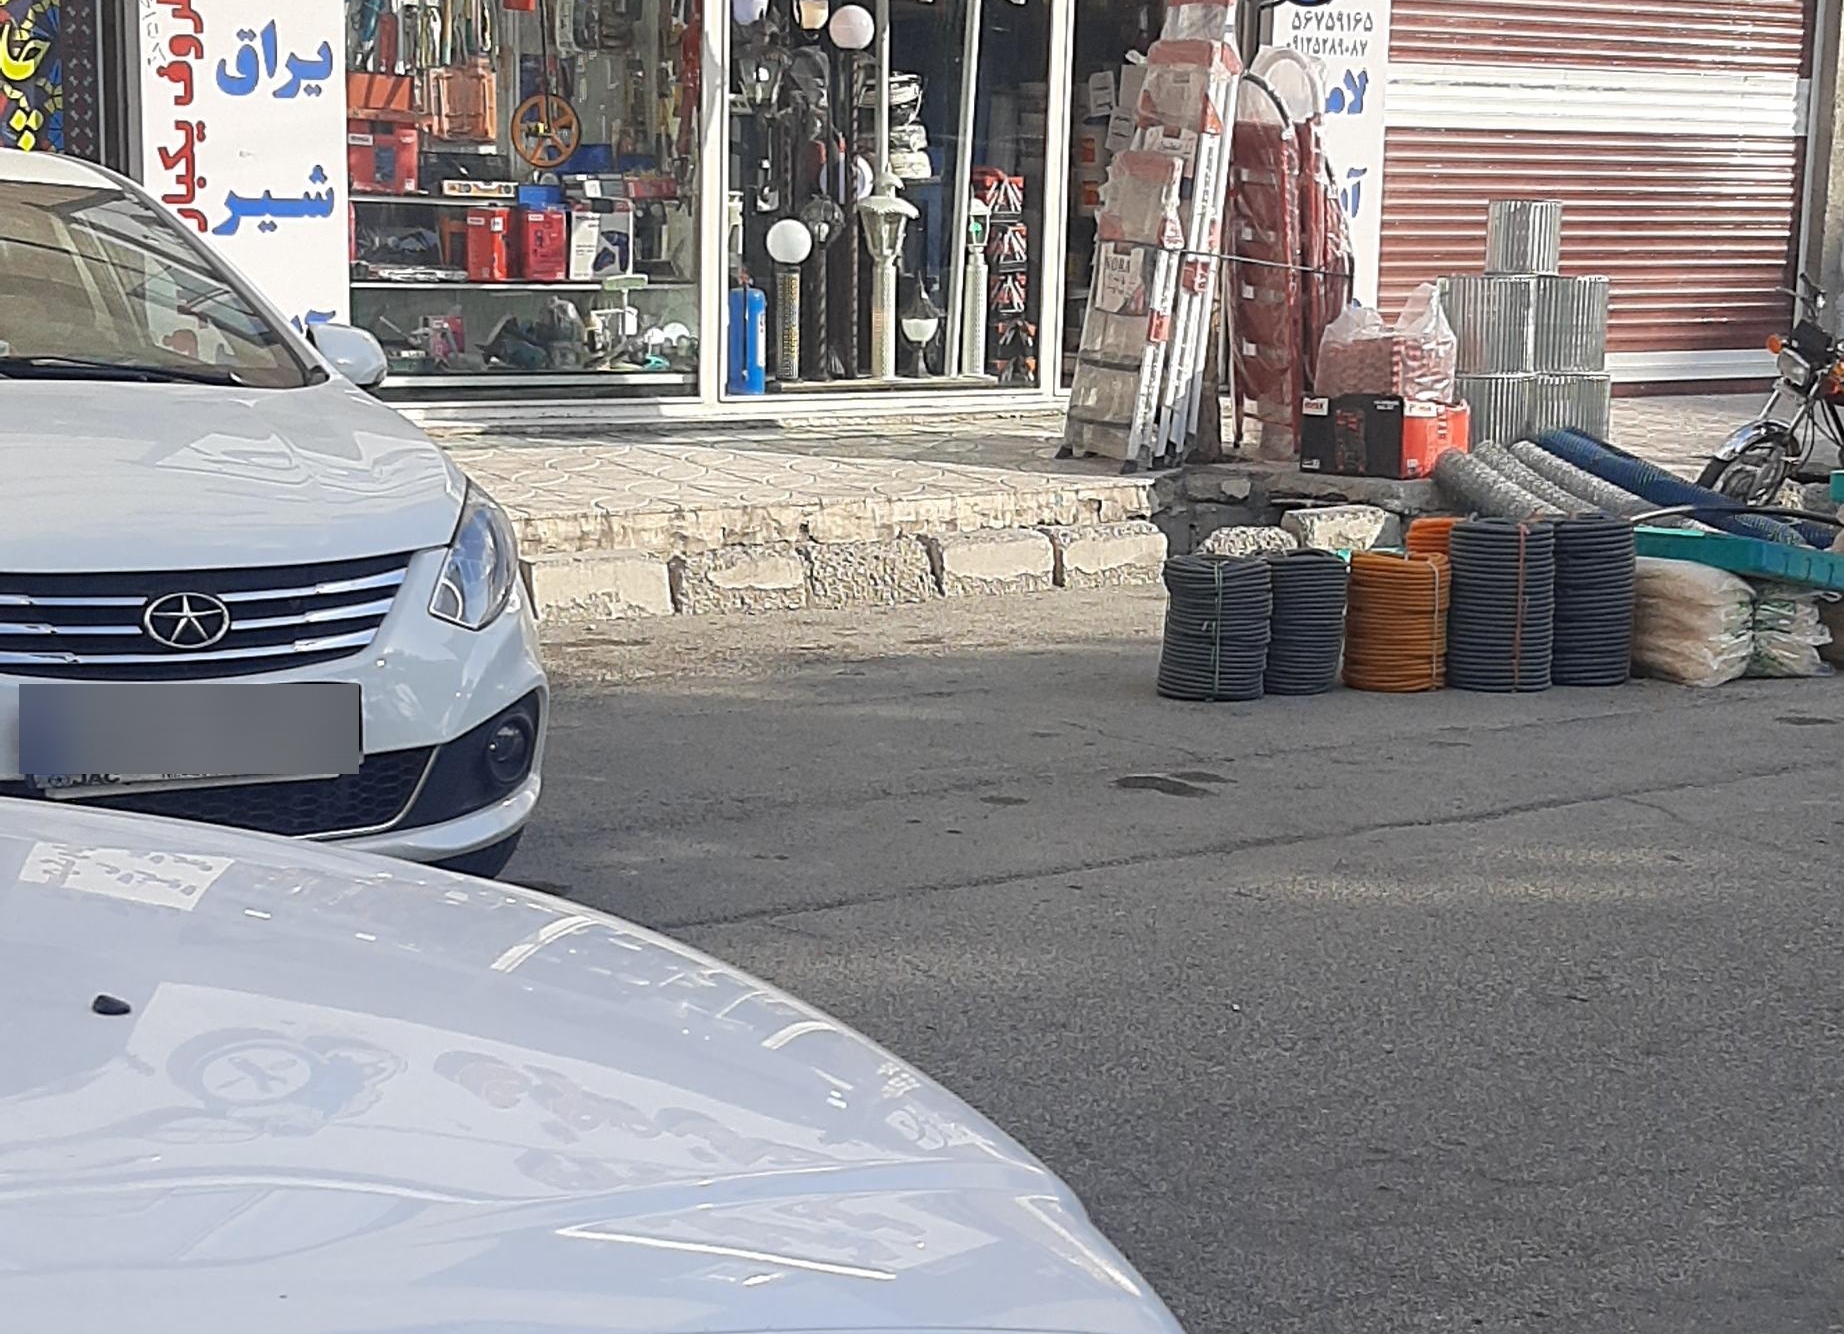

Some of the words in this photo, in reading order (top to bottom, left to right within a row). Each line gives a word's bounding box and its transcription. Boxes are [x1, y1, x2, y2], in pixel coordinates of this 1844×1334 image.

[216, 19, 334, 99] یراق
[1291, 10, 1374, 33] ۵۶۷۵۹۱۶۵
[157, 120, 208, 233] یکبار
[211, 165, 335, 236] شیر
